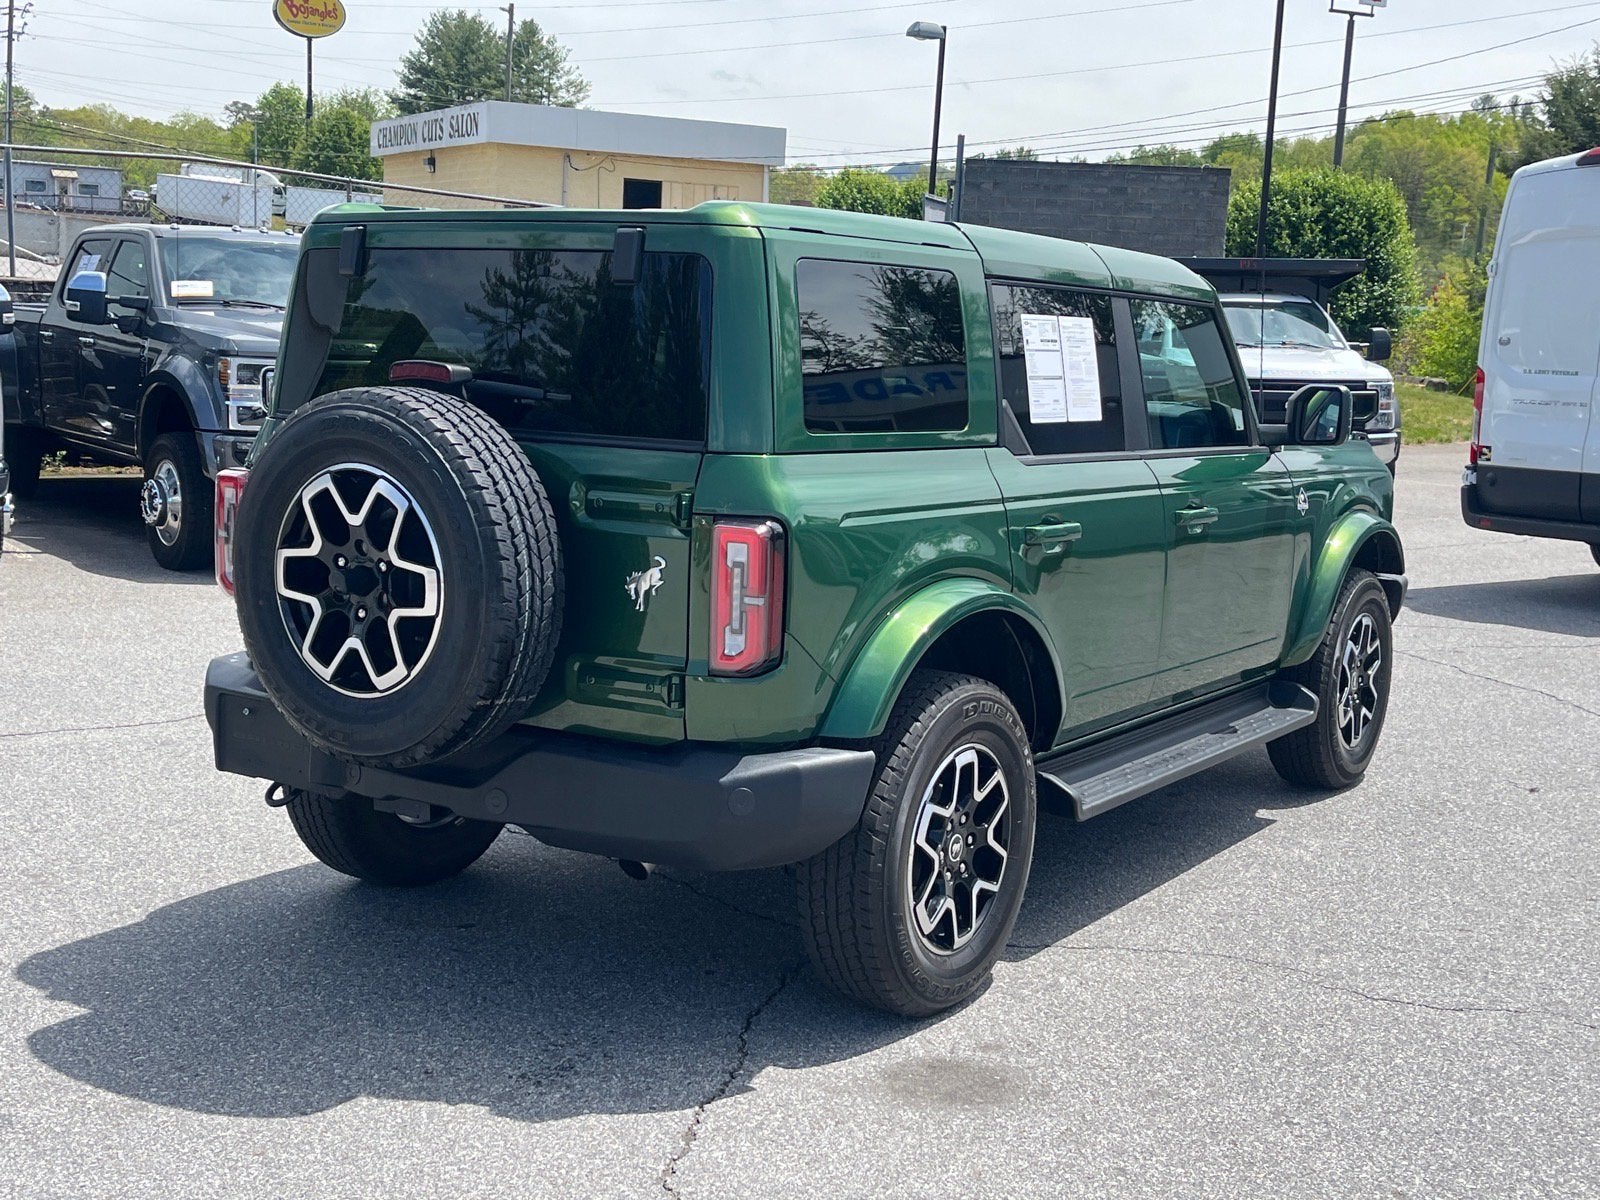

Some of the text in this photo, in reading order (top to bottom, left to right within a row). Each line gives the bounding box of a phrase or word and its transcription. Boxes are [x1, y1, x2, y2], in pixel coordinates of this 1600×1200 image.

[377, 112, 479, 149] CHAMPION CUTS SALON
